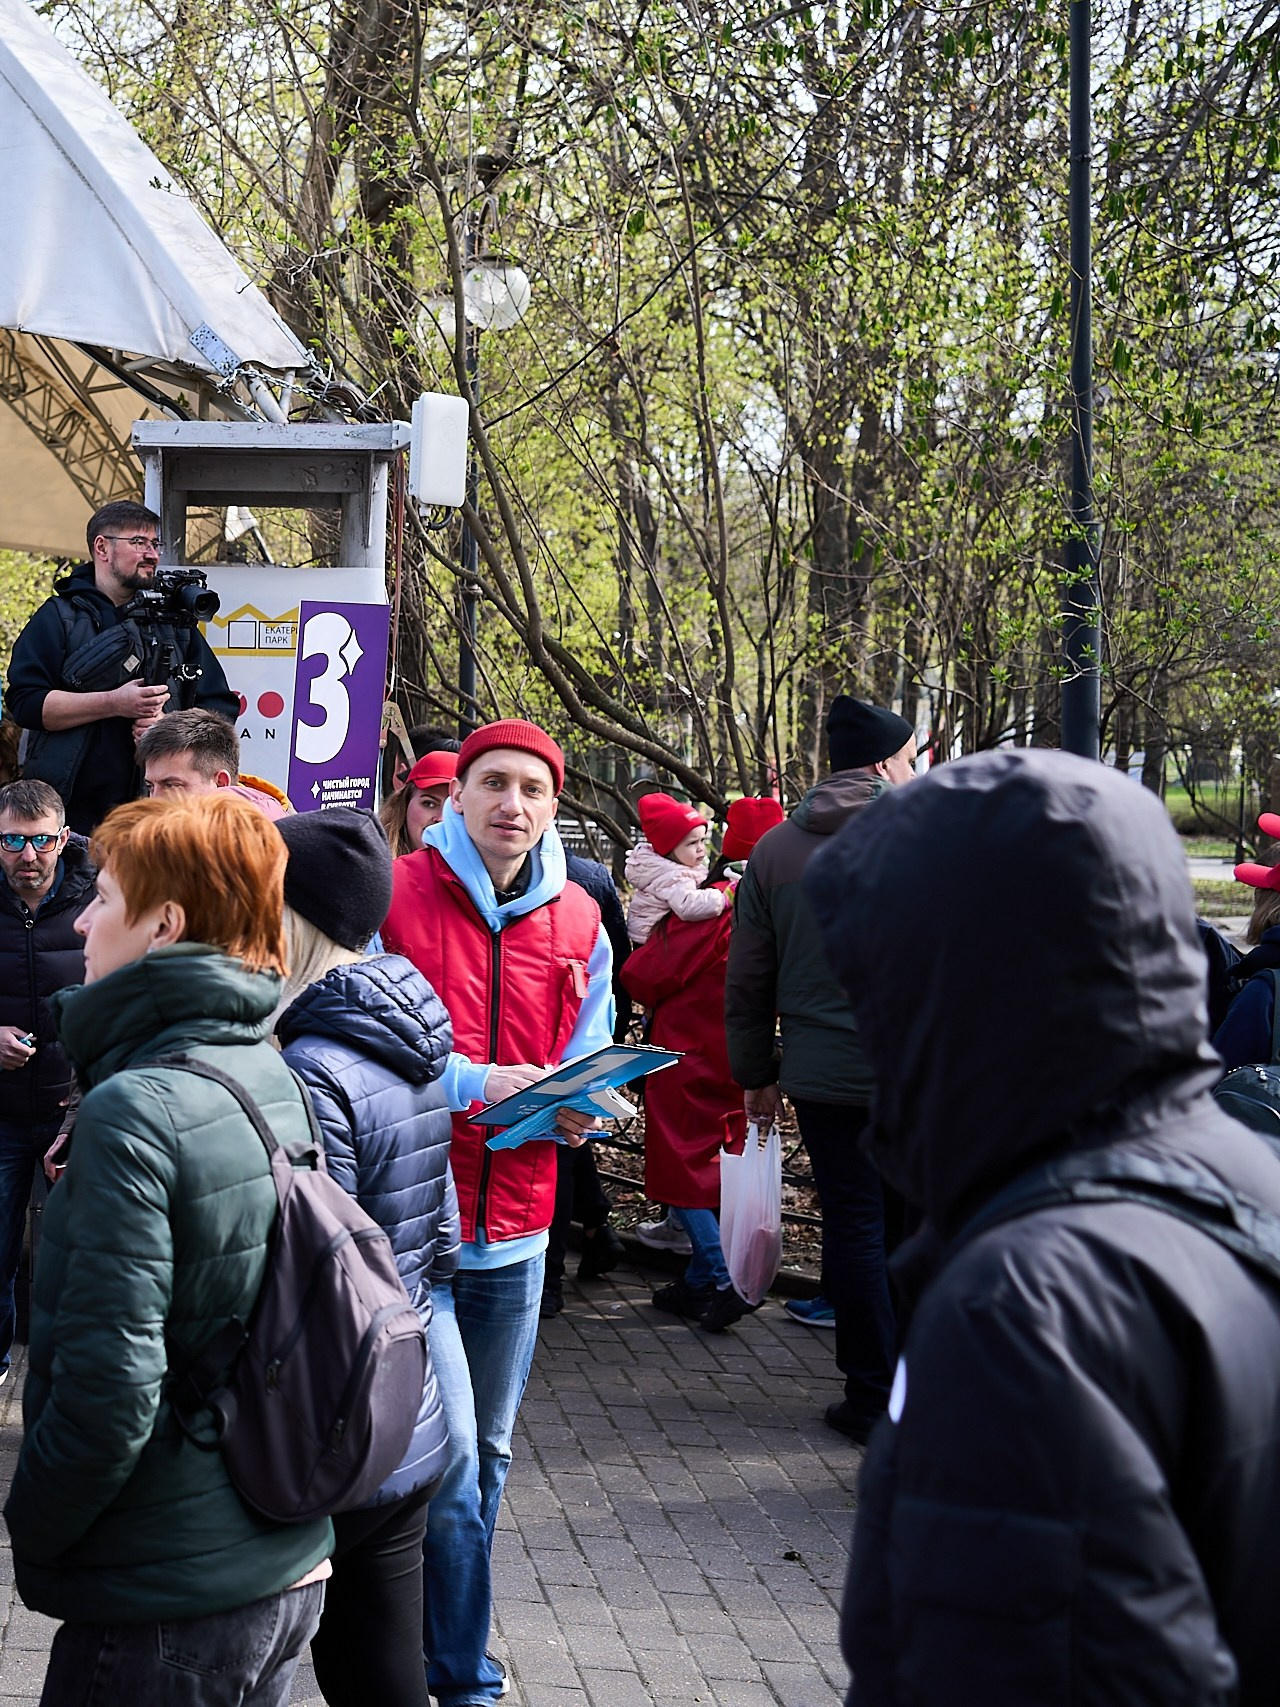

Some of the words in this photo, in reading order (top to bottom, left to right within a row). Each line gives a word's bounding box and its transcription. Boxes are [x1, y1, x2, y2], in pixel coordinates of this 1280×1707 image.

[265, 626, 298, 635] ЕКАТЕР
[265, 636, 288, 644] ПАРК
[294, 612, 352, 764] 3
[322, 776, 350, 790] ЧИСТЫЙ
[350, 777, 370, 789] ГОРОД
[321, 789, 363, 802] НАЧИНАЕТСЯ
